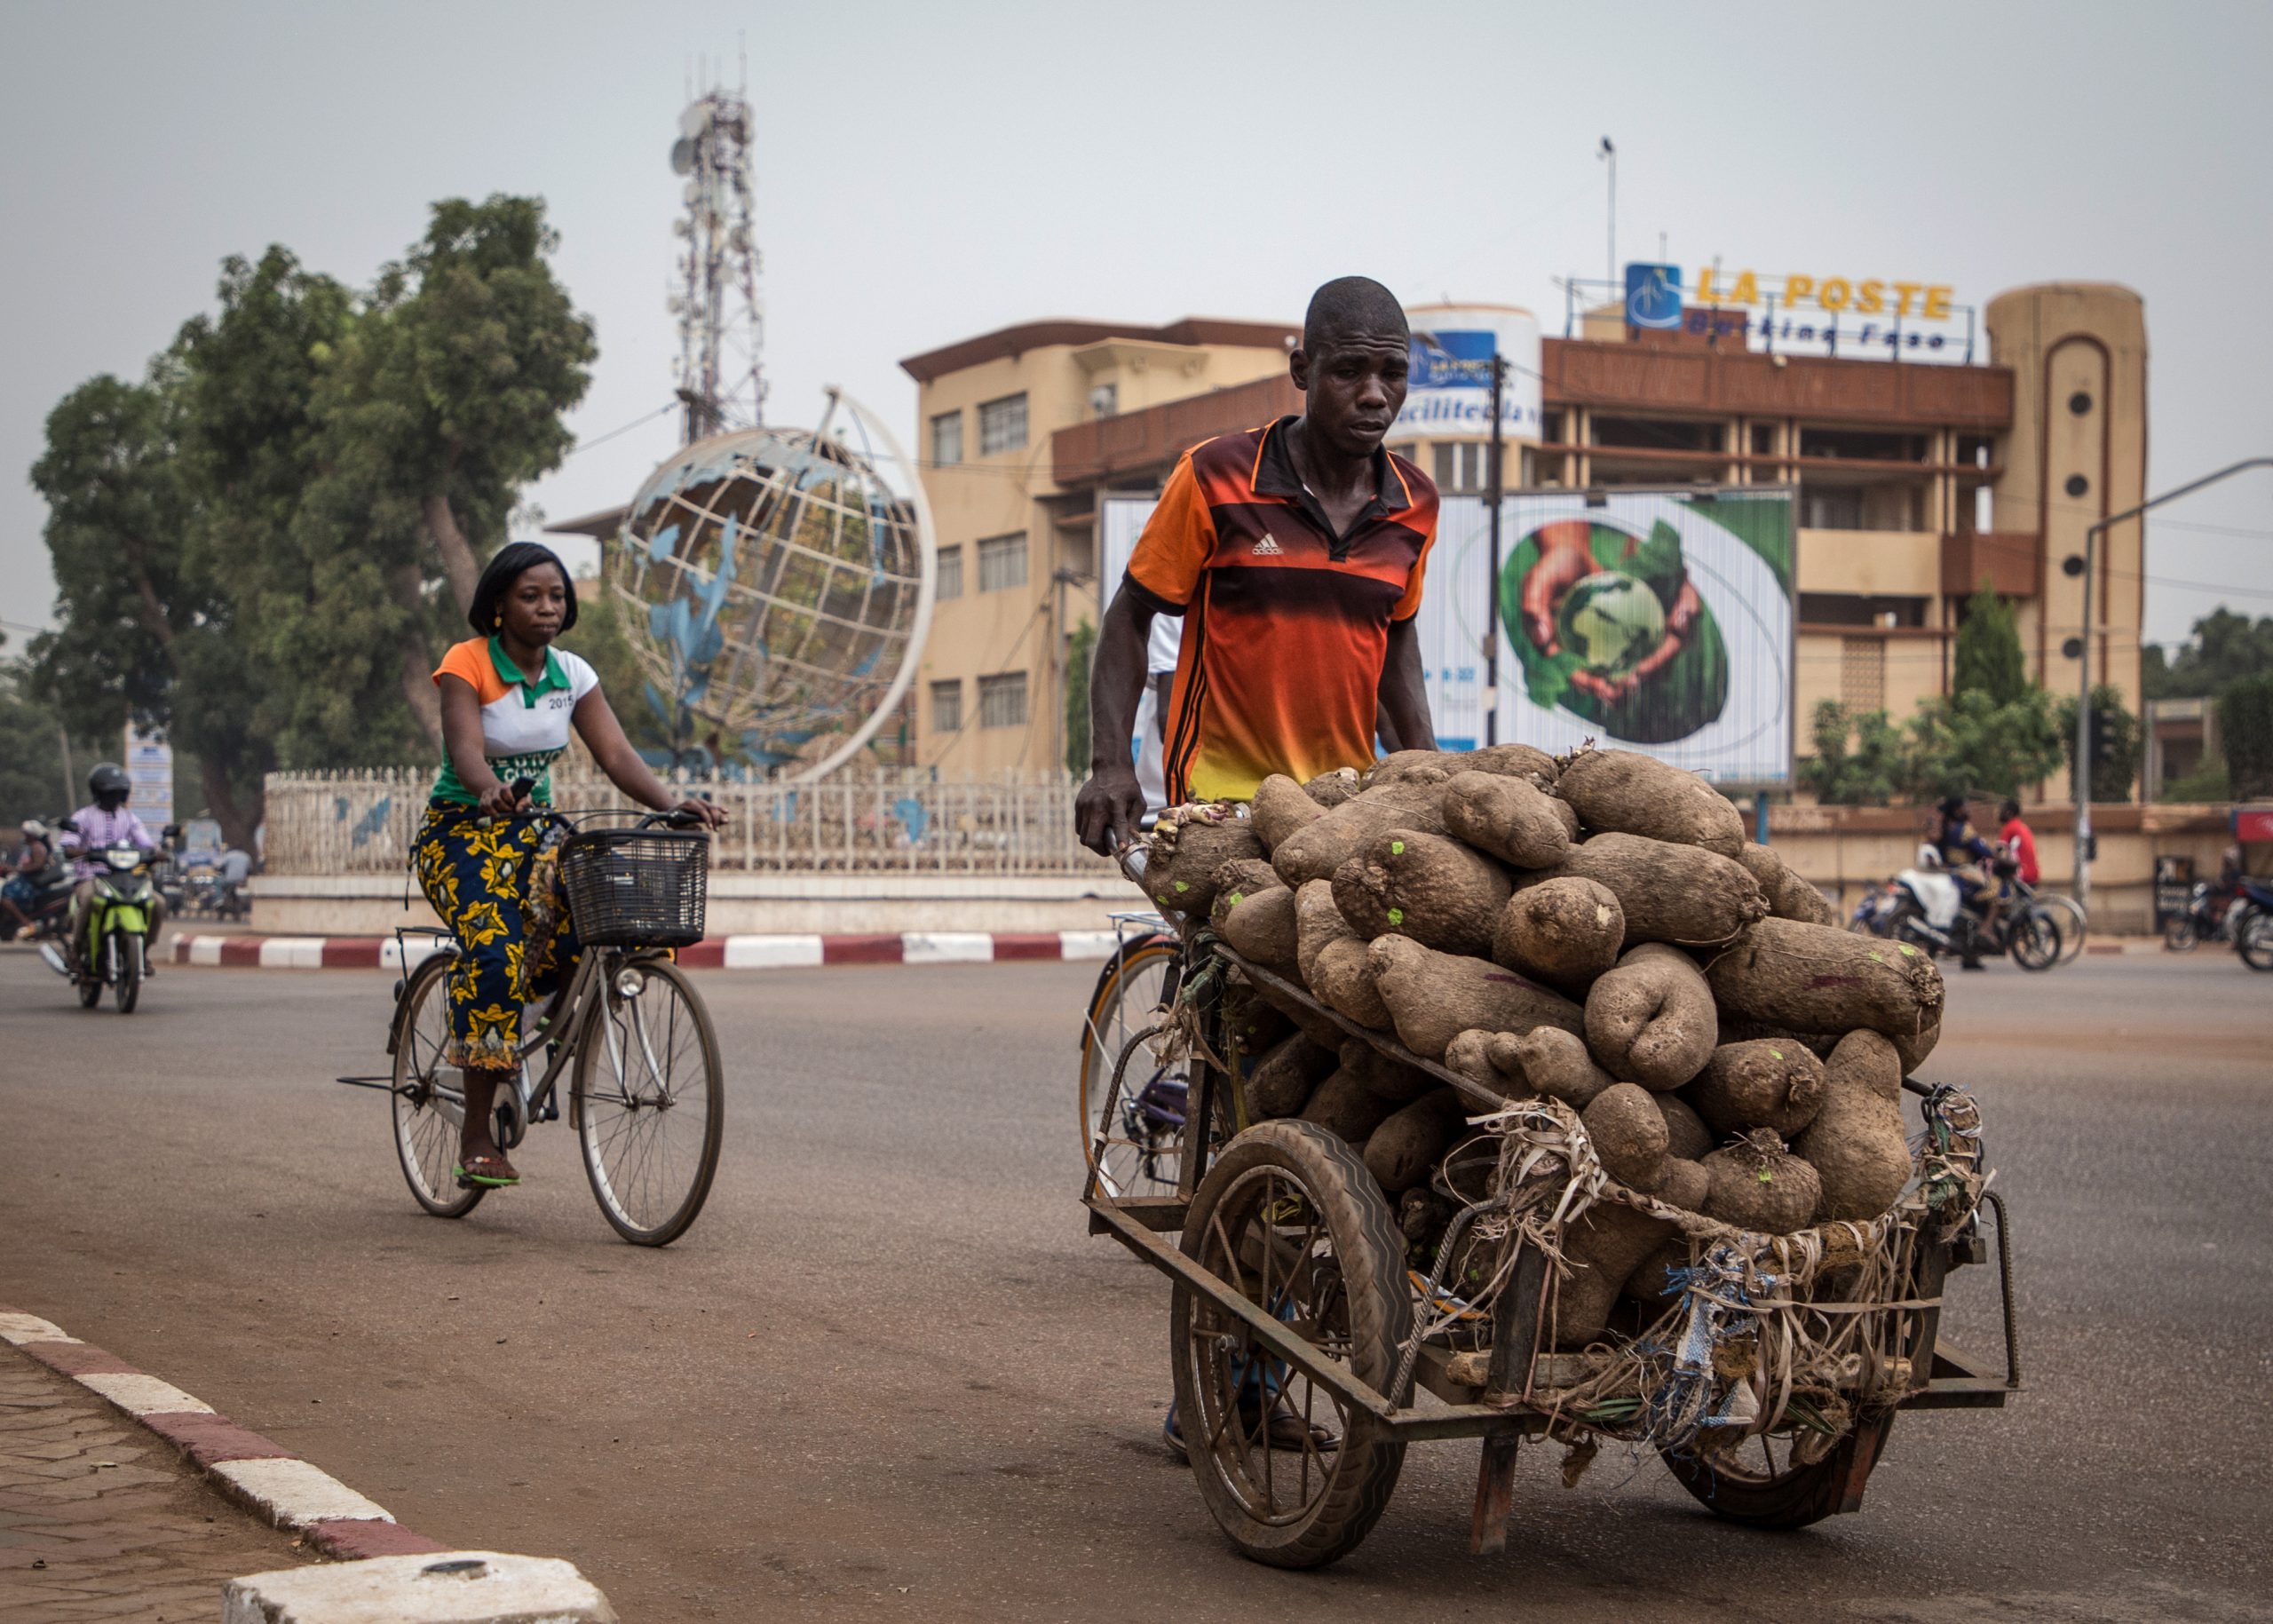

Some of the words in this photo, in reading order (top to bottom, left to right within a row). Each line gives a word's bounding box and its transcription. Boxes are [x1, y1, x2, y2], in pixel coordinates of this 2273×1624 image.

[1697, 268, 1759, 304] LA
[1784, 273, 1953, 321] POSTE
[1859, 322, 1945, 351] Faso
[549, 695, 574, 709] 2015
